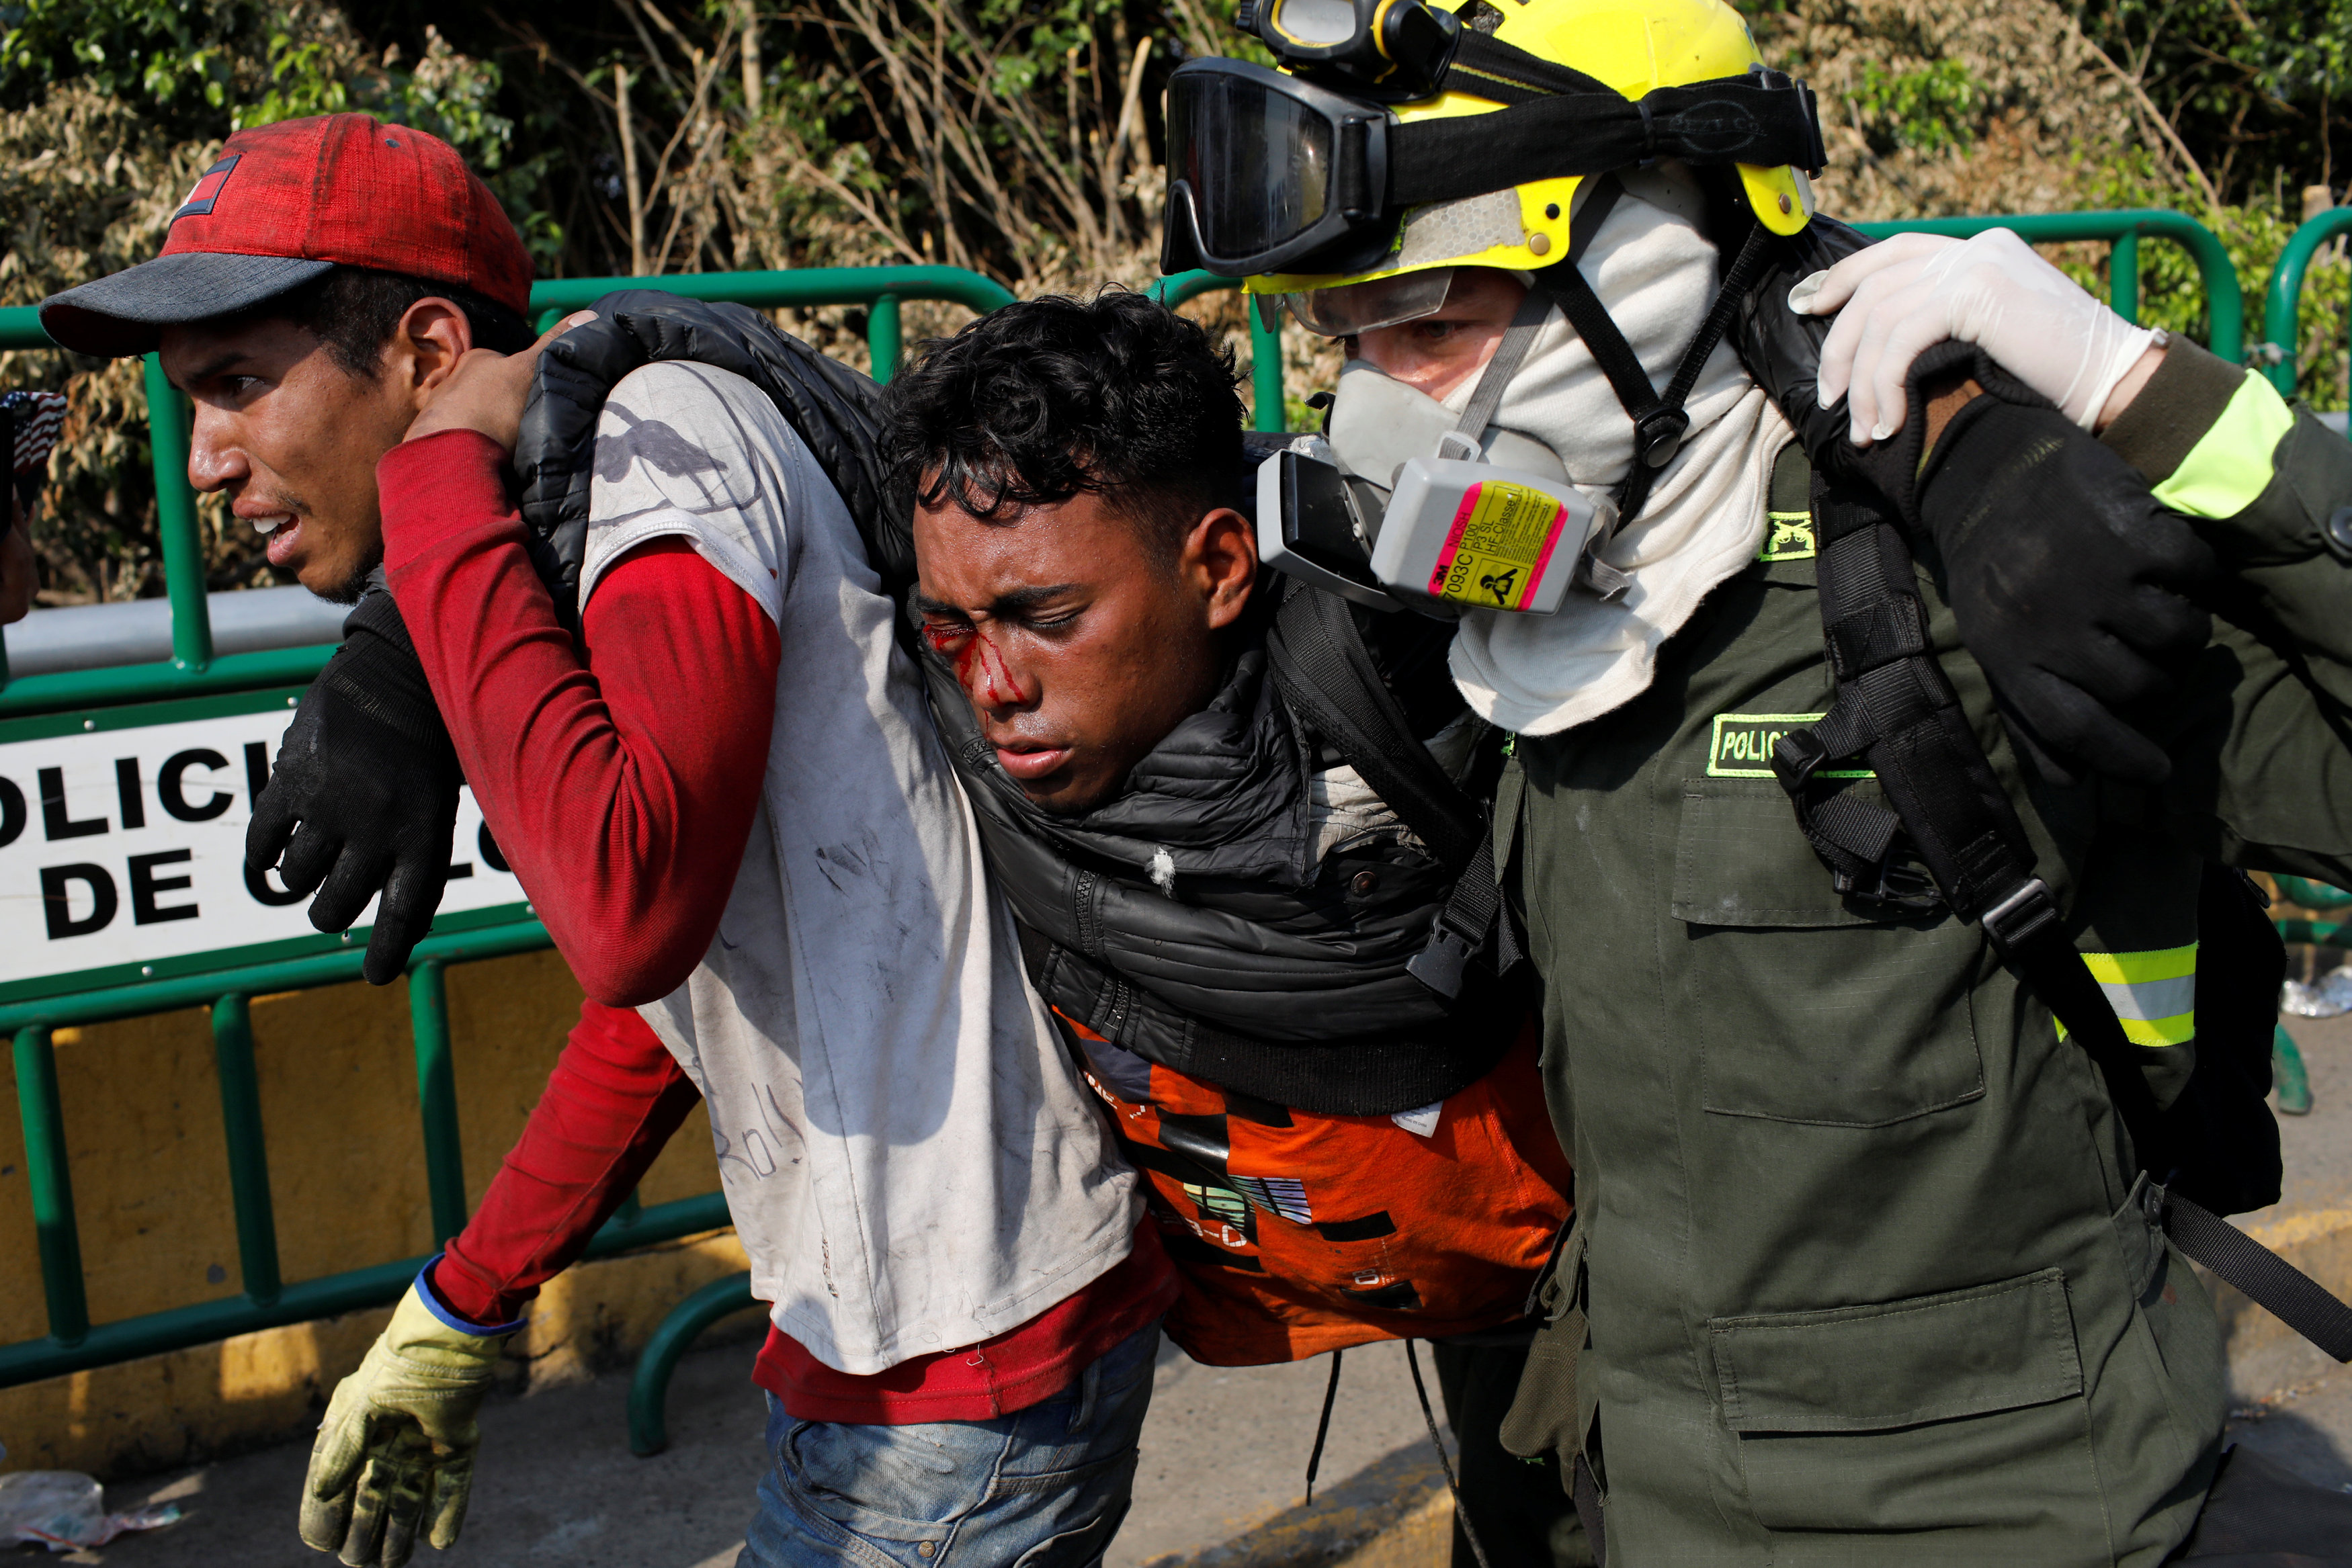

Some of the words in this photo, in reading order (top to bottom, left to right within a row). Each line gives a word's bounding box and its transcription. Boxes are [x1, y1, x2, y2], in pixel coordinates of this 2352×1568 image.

[1447, 511, 1471, 548] NIOSH
[1459, 523, 1479, 550] P100
[1480, 520, 1495, 533] SL
[1487, 500, 1517, 554] HF-Classe
[1474, 535, 1487, 551] P3
[1433, 564, 1450, 586] 3M
[1442, 554, 1473, 603] 7093C
[1720, 730, 1788, 762] POLIC
[39, 848, 200, 940] DE
